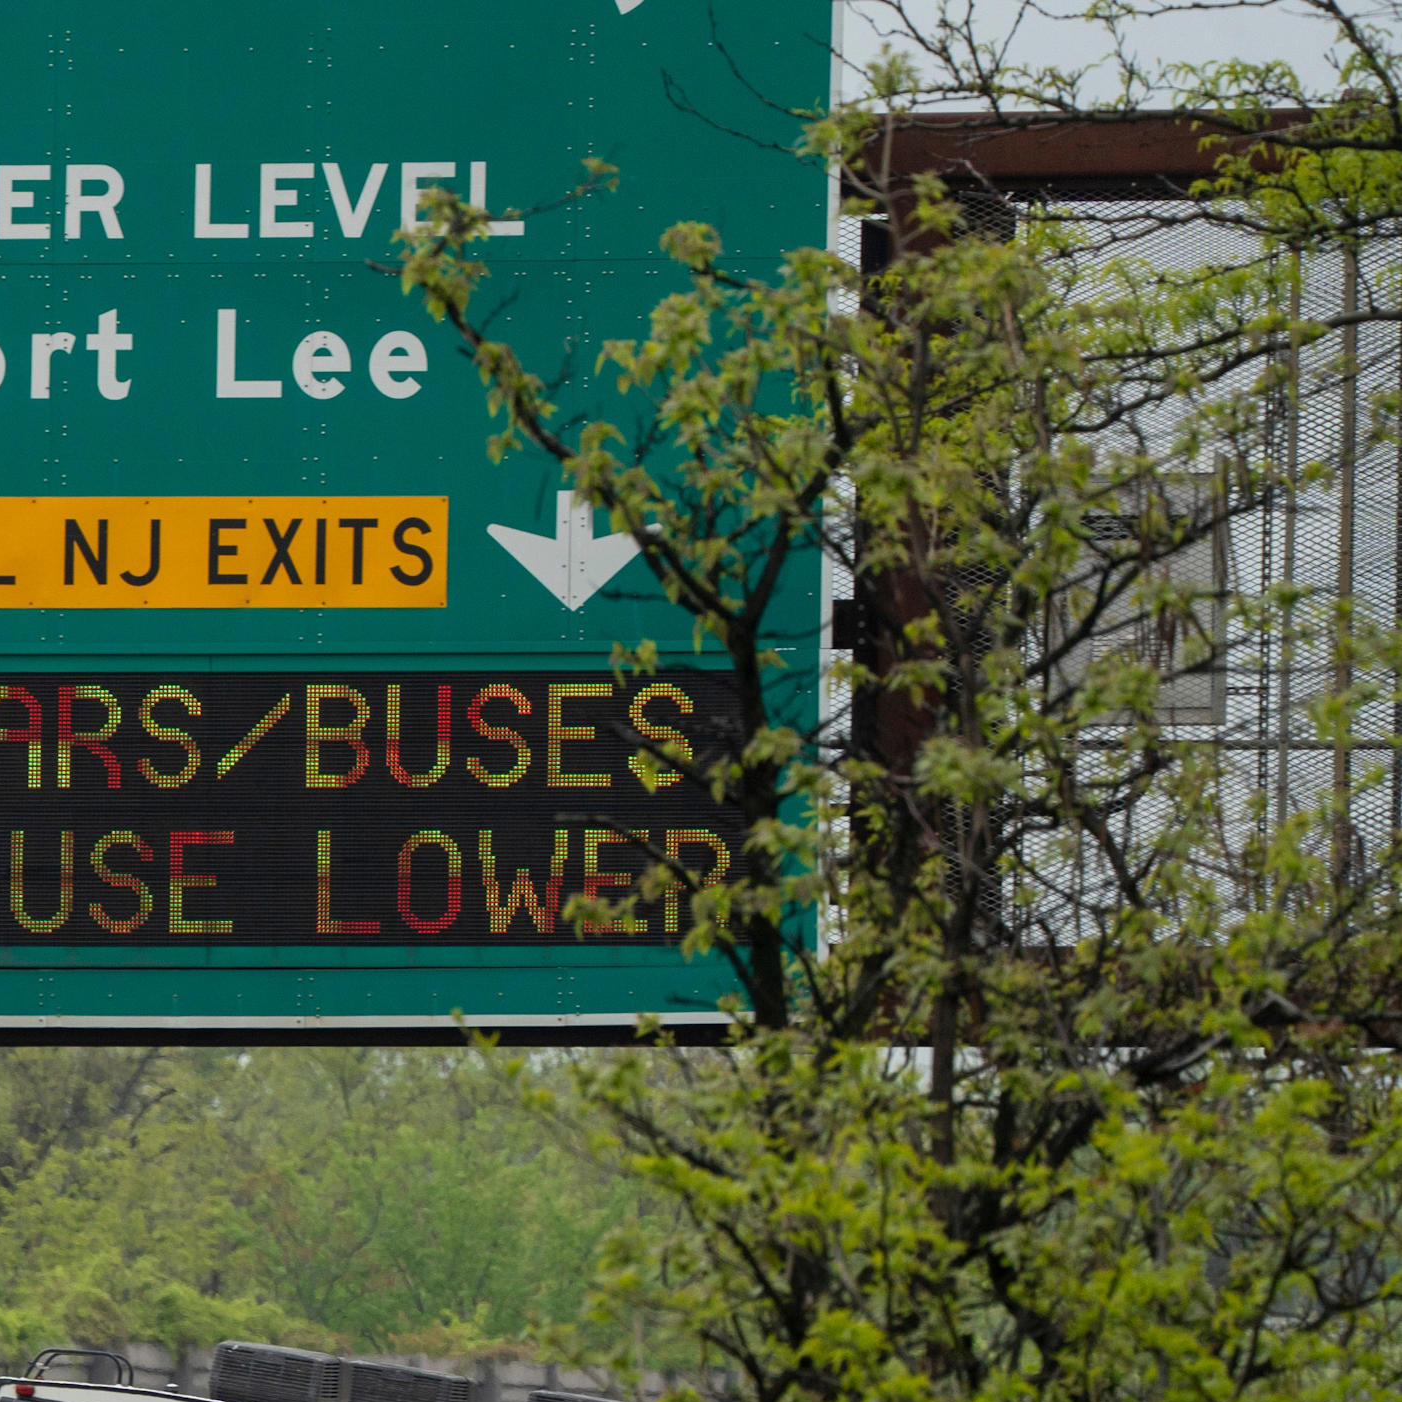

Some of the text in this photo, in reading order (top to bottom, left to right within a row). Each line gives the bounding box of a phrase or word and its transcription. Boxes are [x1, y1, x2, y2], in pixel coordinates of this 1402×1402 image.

[194, 161, 525, 239] LEVEL
[216, 308, 429, 400] Lee
[64, 519, 161, 588] NJ
[208, 517, 434, 587] EXITS
[10, 829, 236, 934] USE
[316, 828, 732, 934] LOWER
